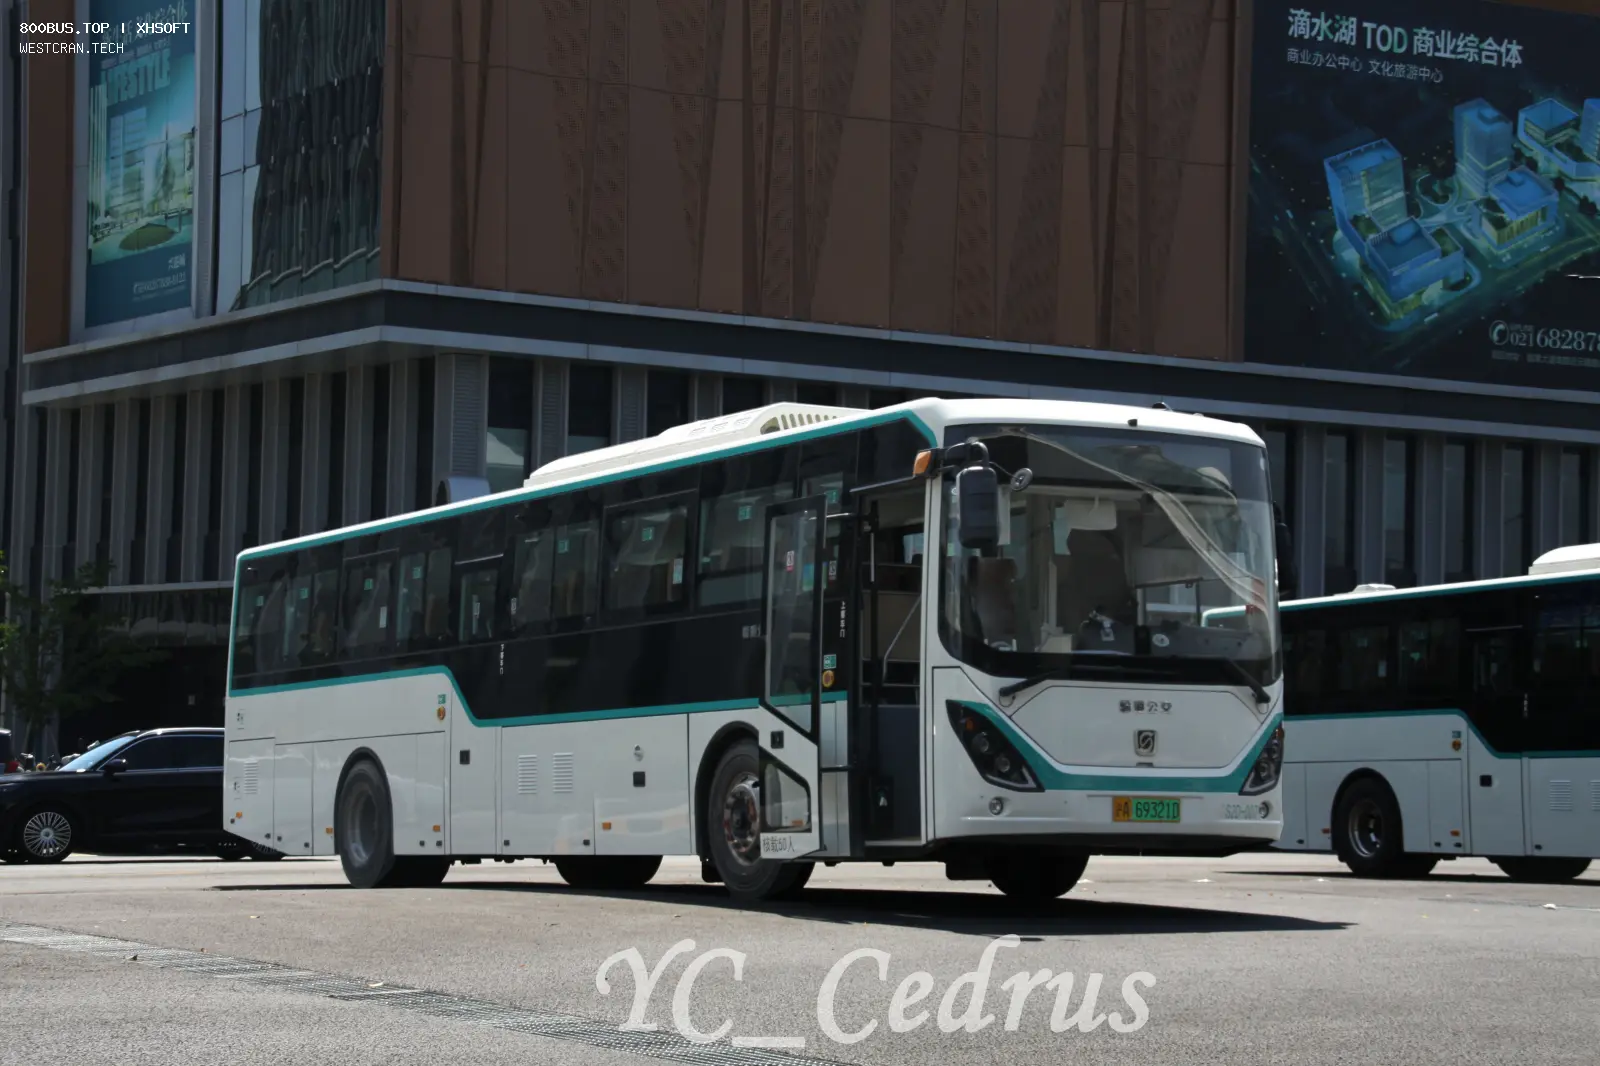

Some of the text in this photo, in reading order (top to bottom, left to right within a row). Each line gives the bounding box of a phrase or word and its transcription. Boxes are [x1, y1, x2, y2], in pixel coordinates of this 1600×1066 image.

[1288, 8, 1523, 68] 滴水湖 TOD 商业综合体
[1287, 48, 1445, 83] 商业办公中心 文化旅游中心
